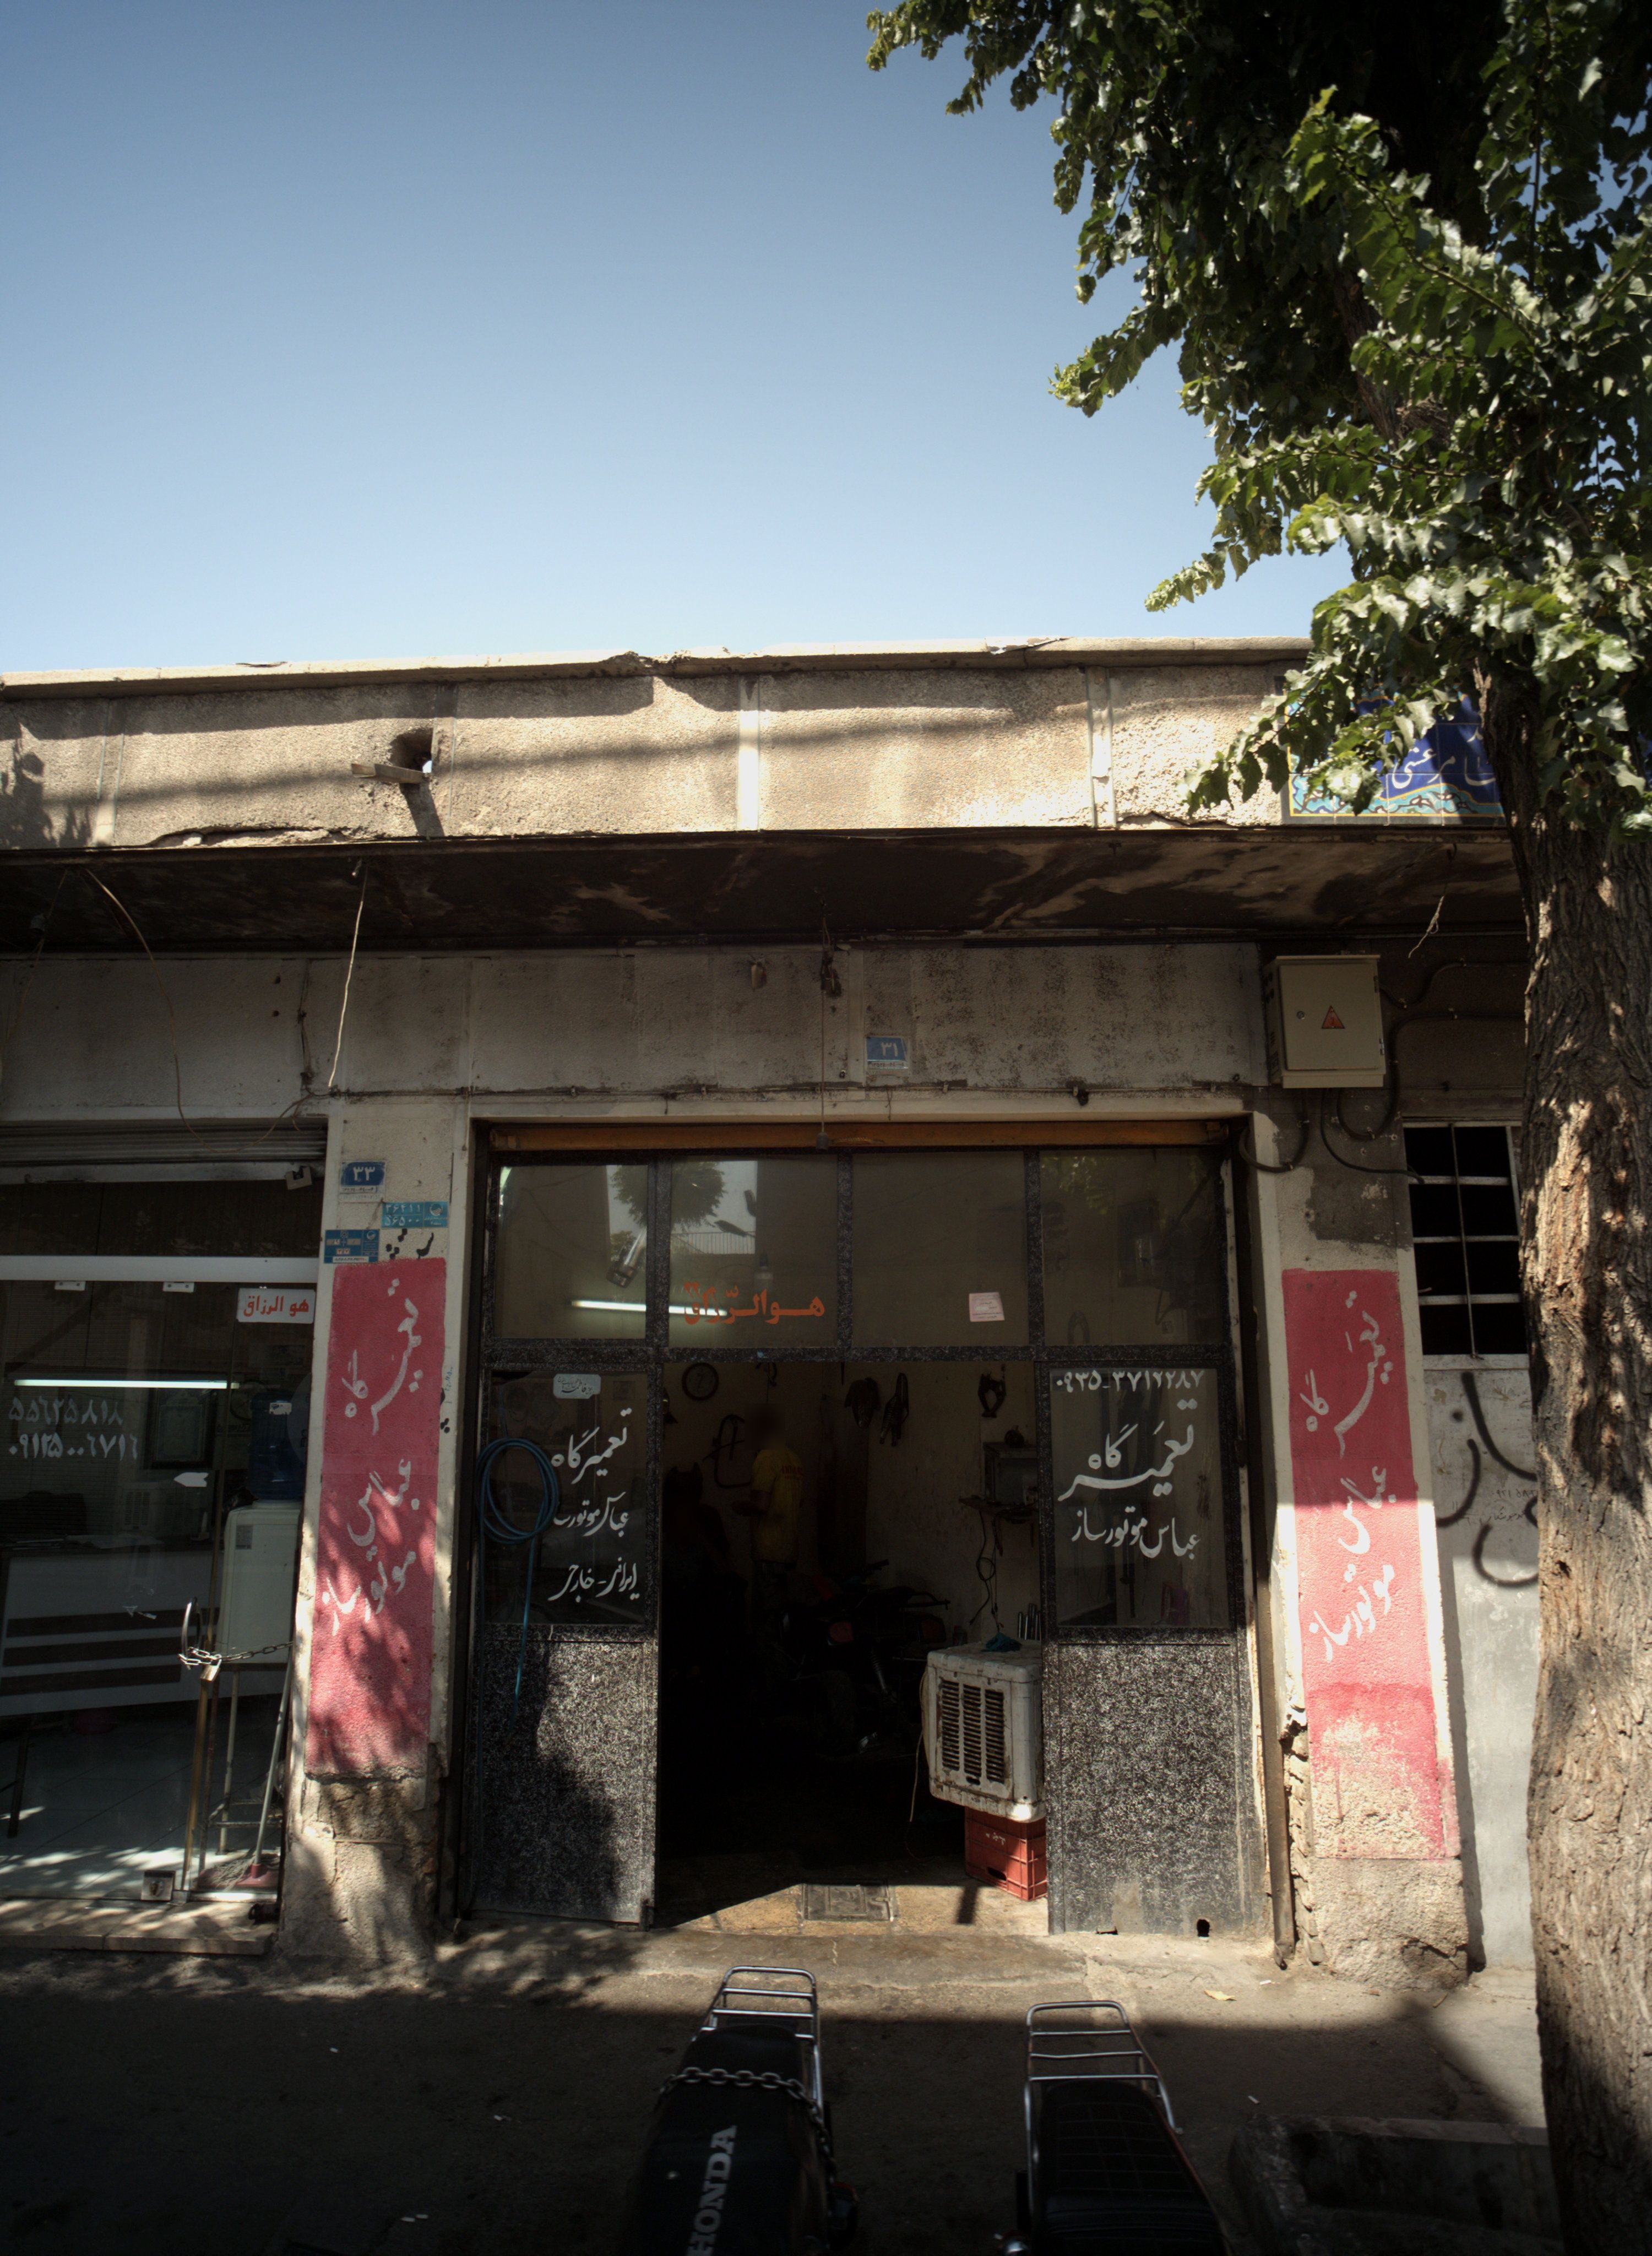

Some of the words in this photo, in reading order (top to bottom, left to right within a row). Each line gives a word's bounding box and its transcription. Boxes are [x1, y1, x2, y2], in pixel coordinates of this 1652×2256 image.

[881, 1042, 899, 1057] ۳۱
[352, 1167, 375, 1181] ۳۳
[686, 2125, 738, 2256] HONDA
